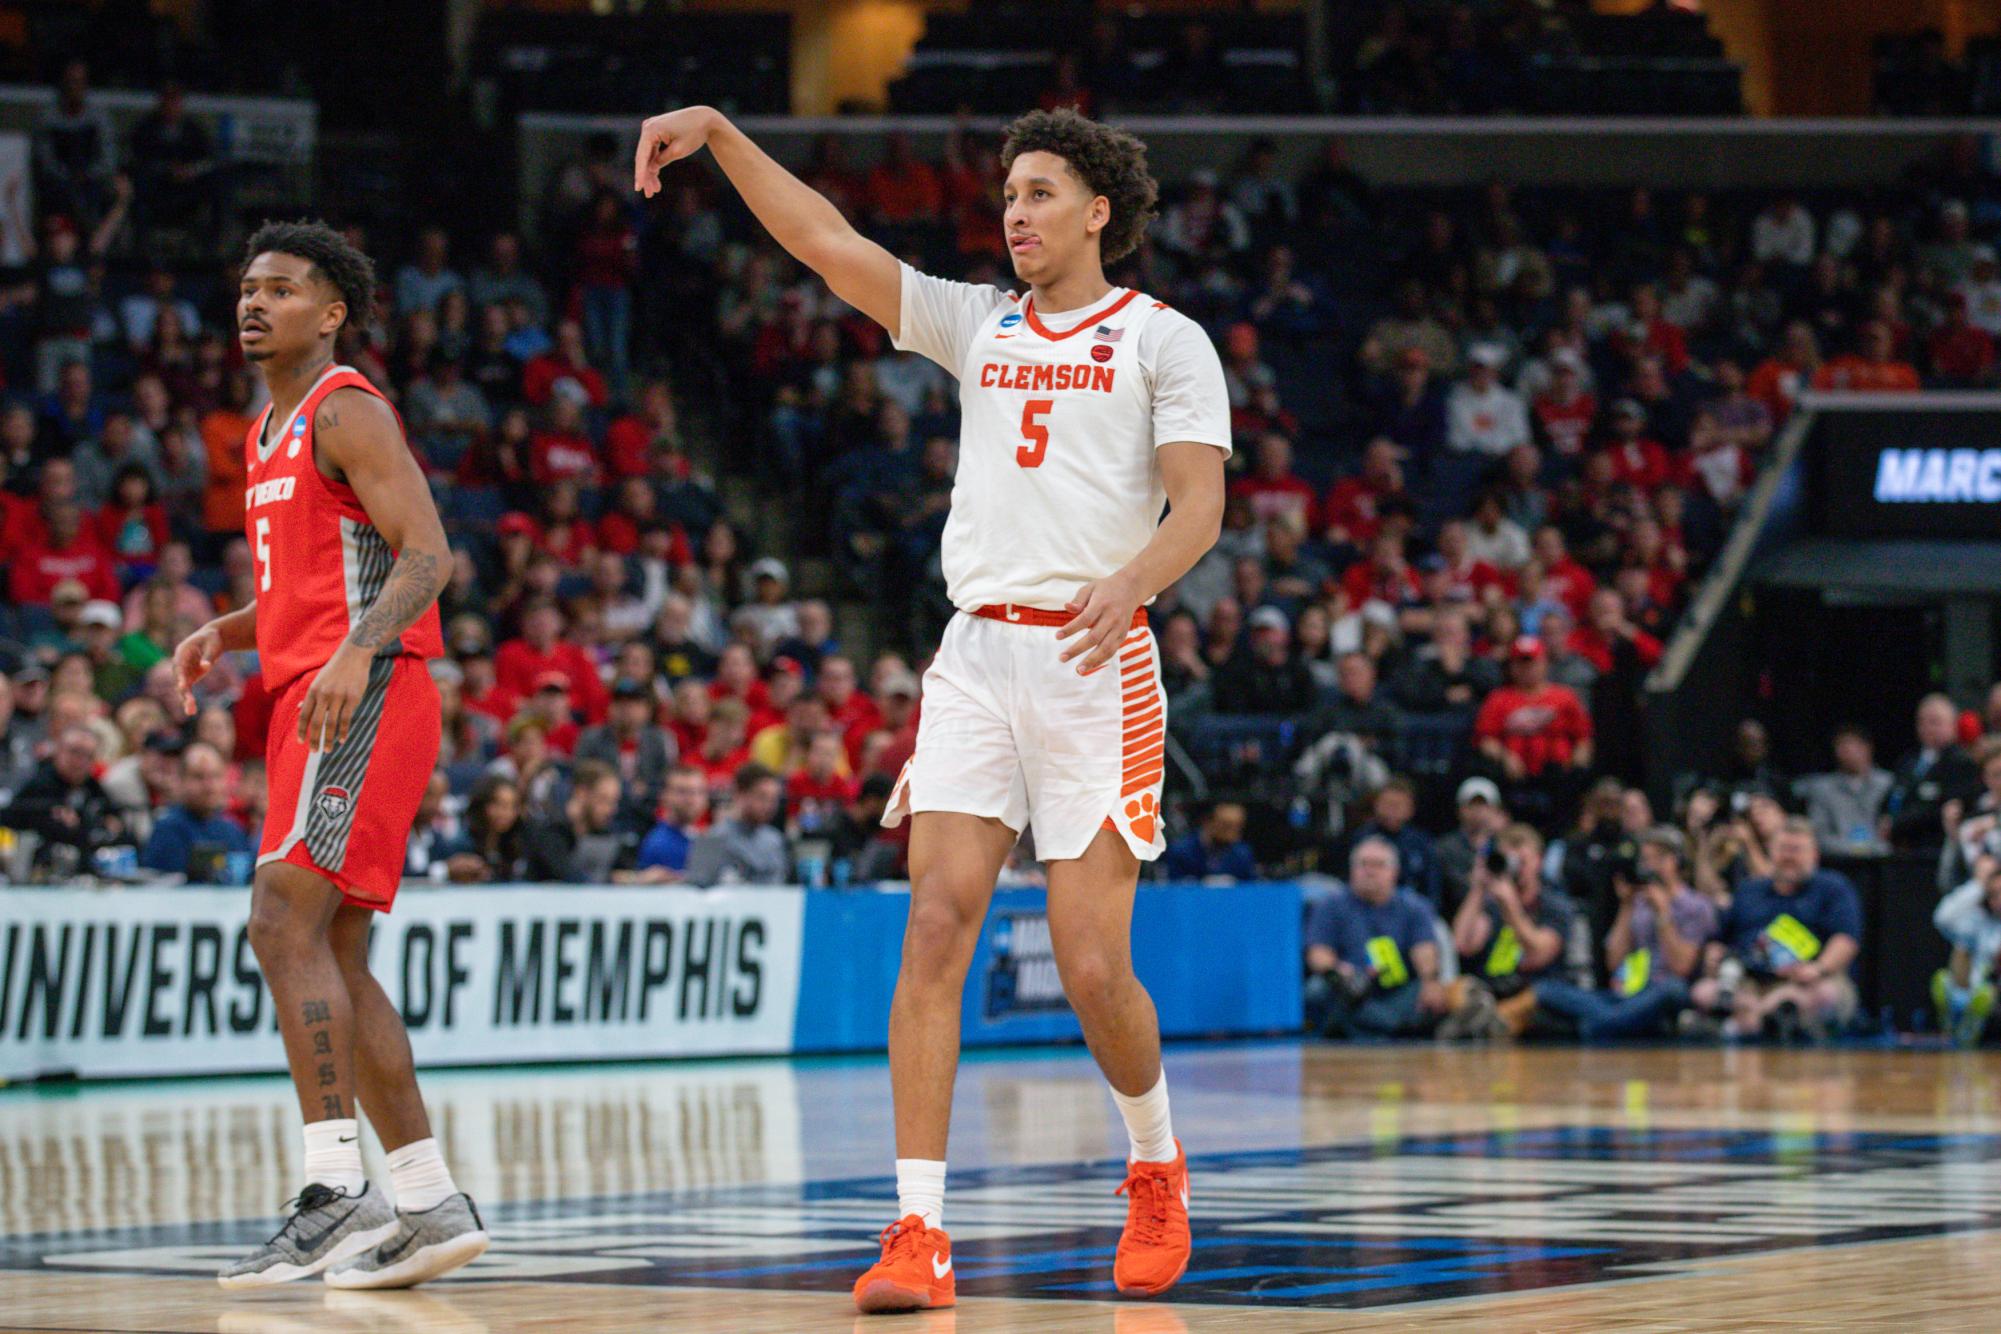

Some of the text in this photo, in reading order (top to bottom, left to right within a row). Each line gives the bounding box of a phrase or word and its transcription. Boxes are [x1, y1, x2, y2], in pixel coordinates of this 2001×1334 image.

[980, 363, 1115, 392] CLEMSON
[1016, 400, 1054, 468] 5
[255, 517, 272, 592] 5
[0, 916, 767, 1041] NIVERS OF MEMPHIS
